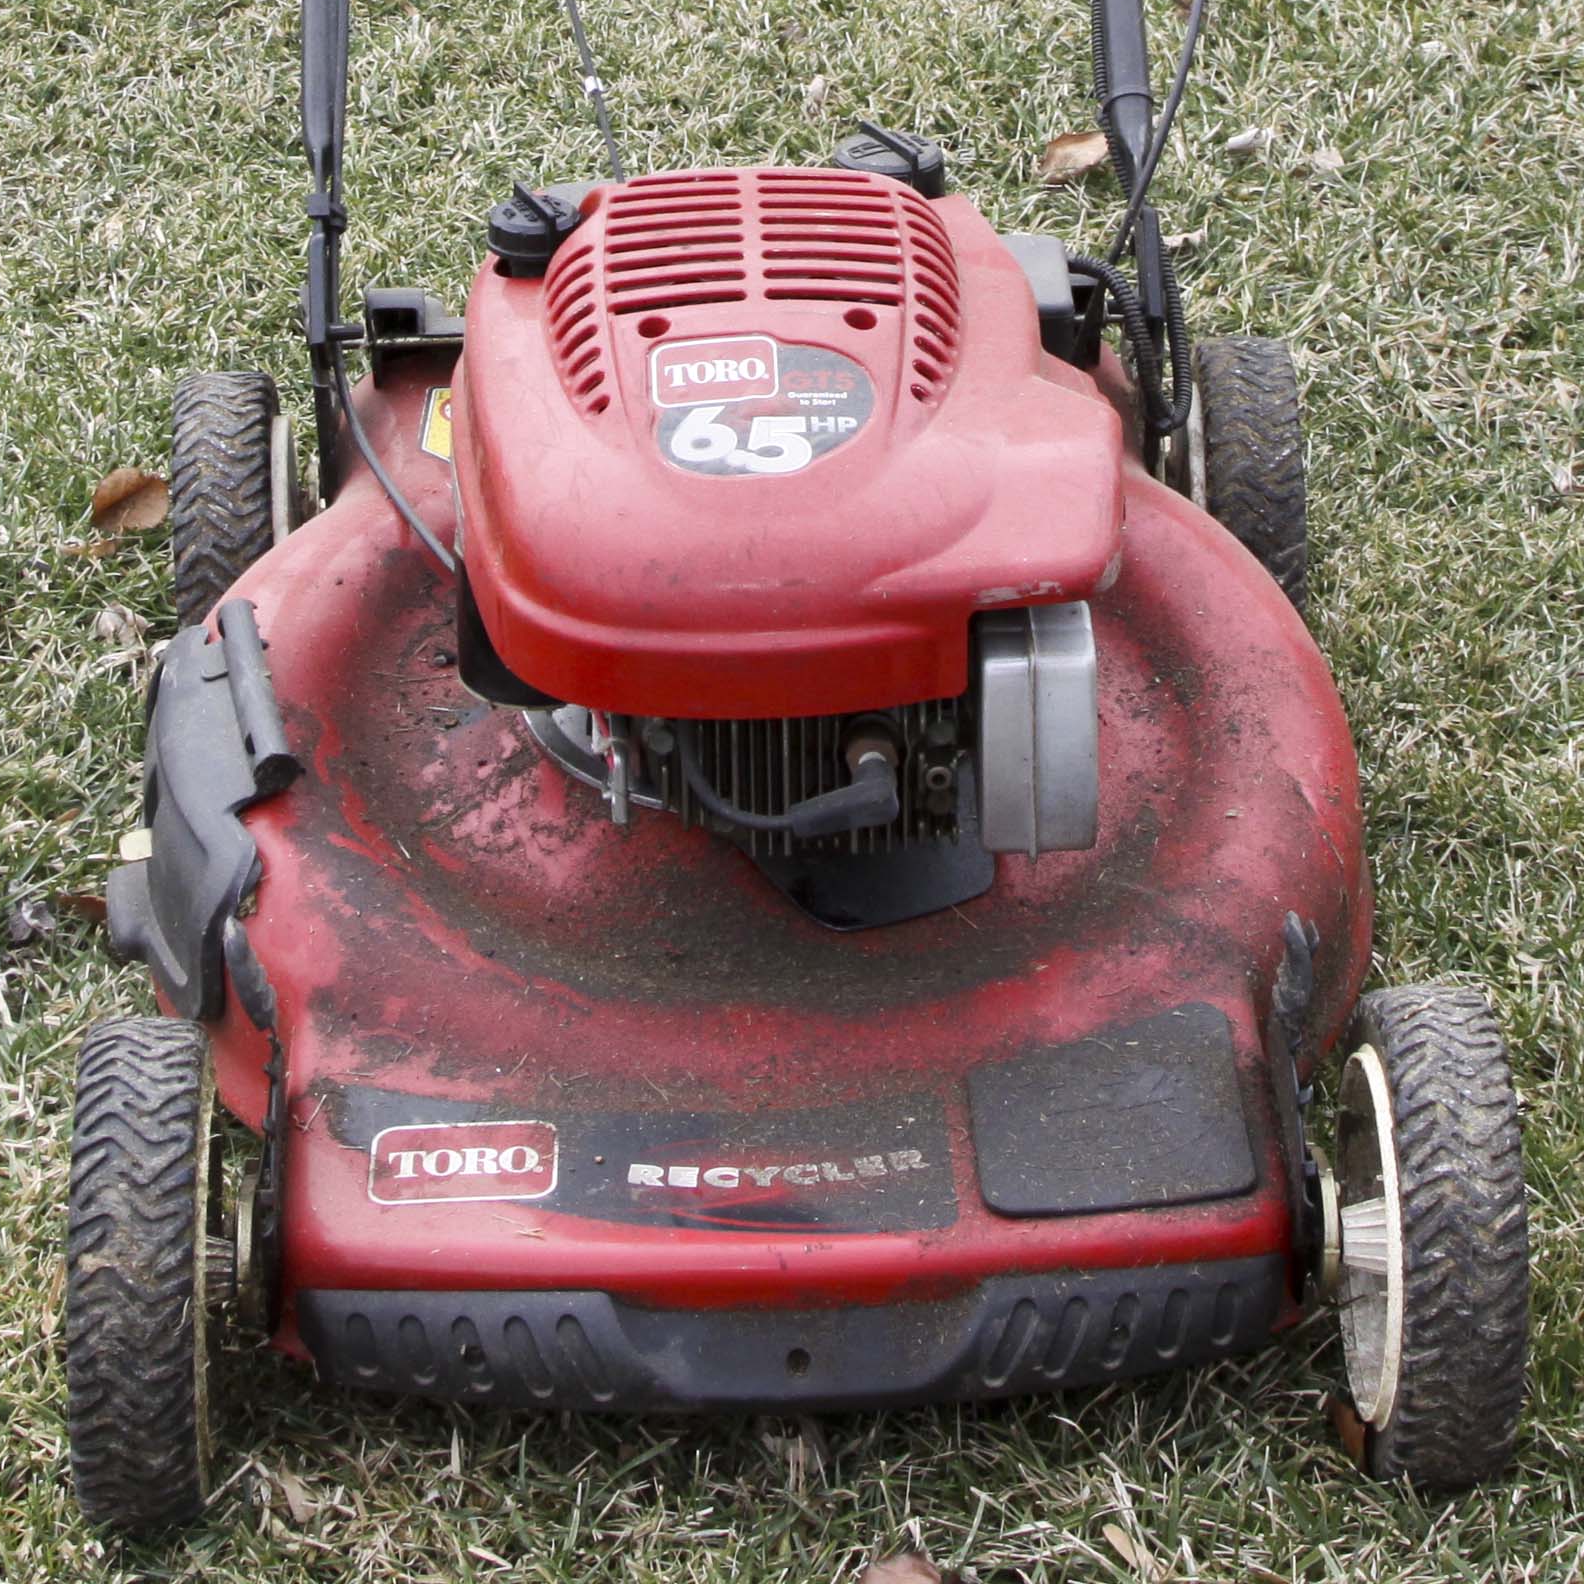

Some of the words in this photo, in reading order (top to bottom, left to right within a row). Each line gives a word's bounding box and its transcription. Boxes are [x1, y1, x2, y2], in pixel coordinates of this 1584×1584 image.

[664, 357, 769, 388] TORO
[810, 416, 858, 433] HP
[388, 1146, 543, 1180] TORO
[627, 1149, 930, 1188] RECYCLER
